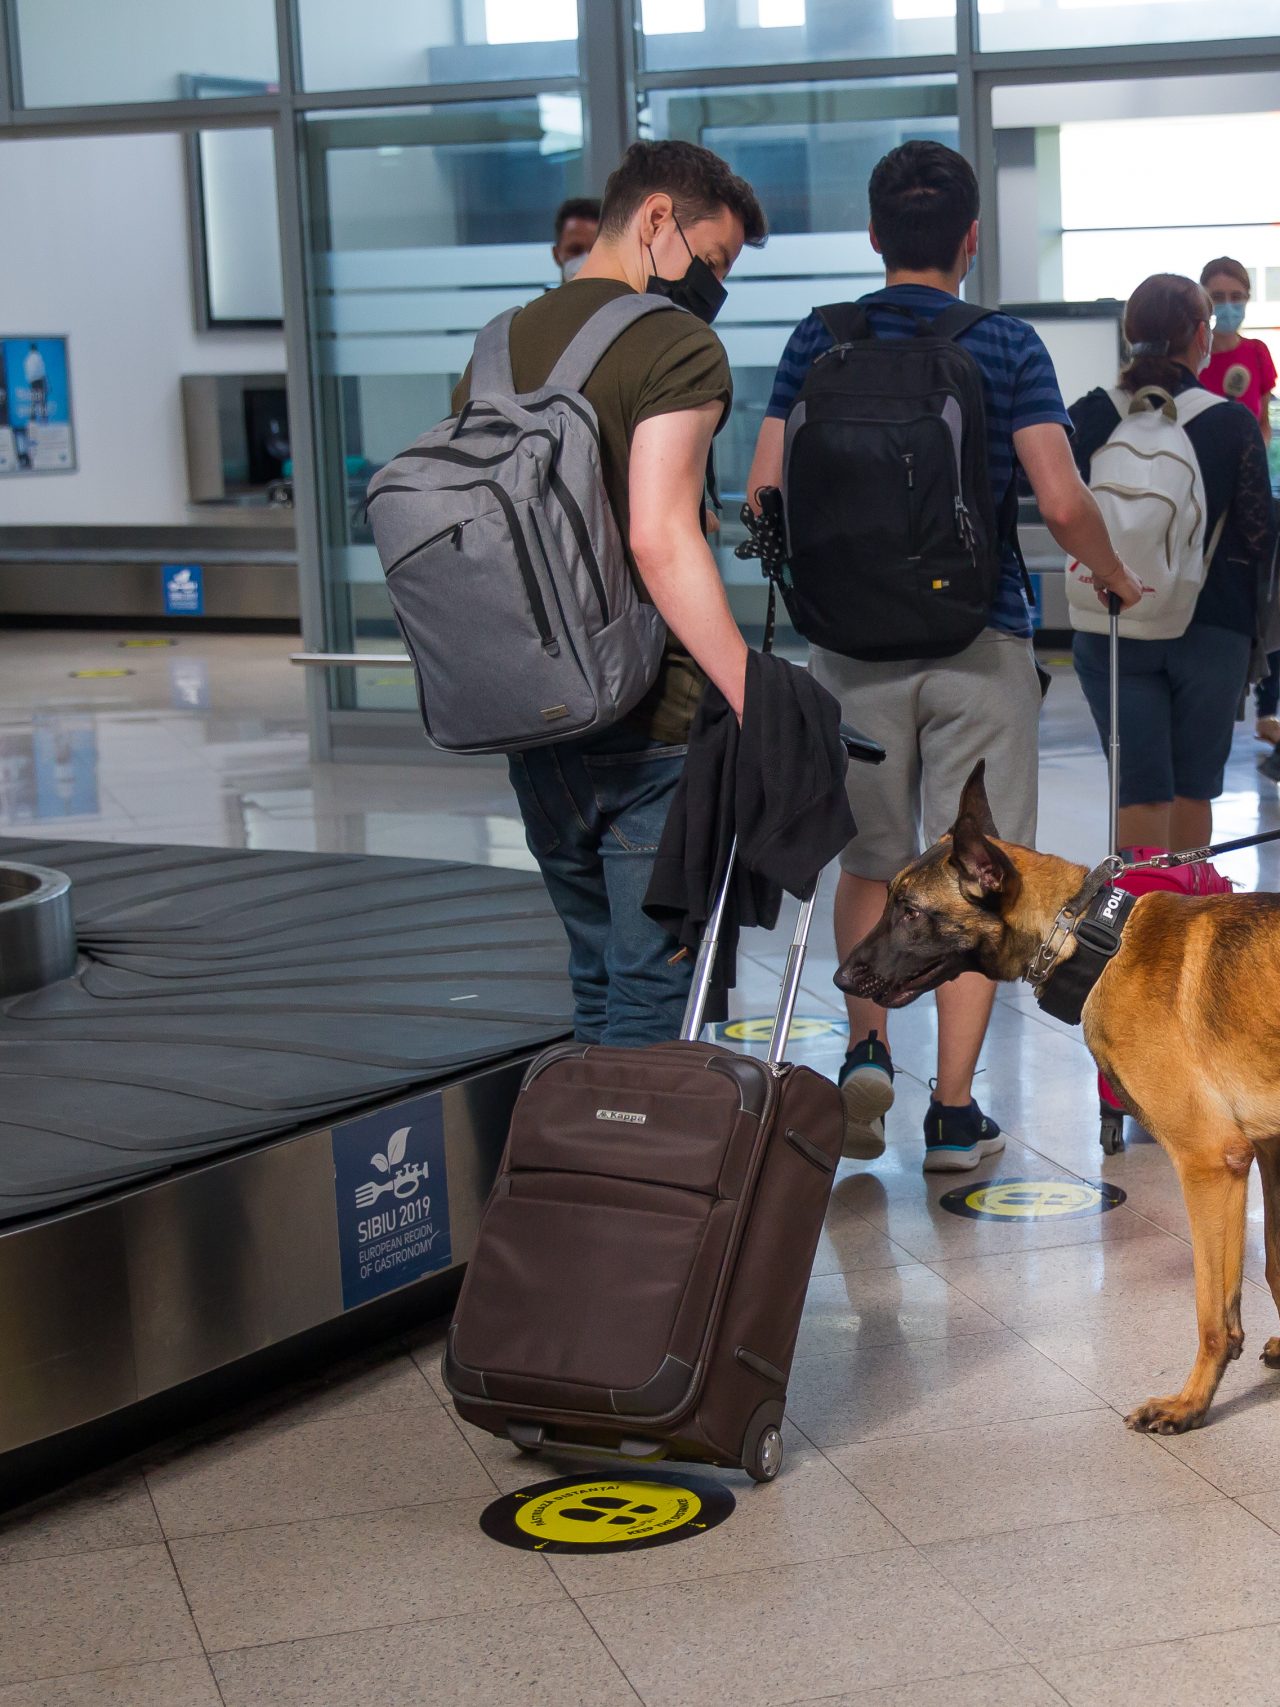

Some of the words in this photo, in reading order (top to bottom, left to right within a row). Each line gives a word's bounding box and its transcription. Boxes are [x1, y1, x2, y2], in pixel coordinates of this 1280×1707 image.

[610, 1111, 644, 1122] Kappa
[358, 1208, 396, 1243] SIBIU
[399, 1195, 431, 1226] 2019
[359, 1233, 402, 1263] EUROPEAN
[404, 1222, 432, 1243] REGION
[360, 1262, 373, 1279] OF
[374, 1238, 433, 1273] GASTRONOMY
